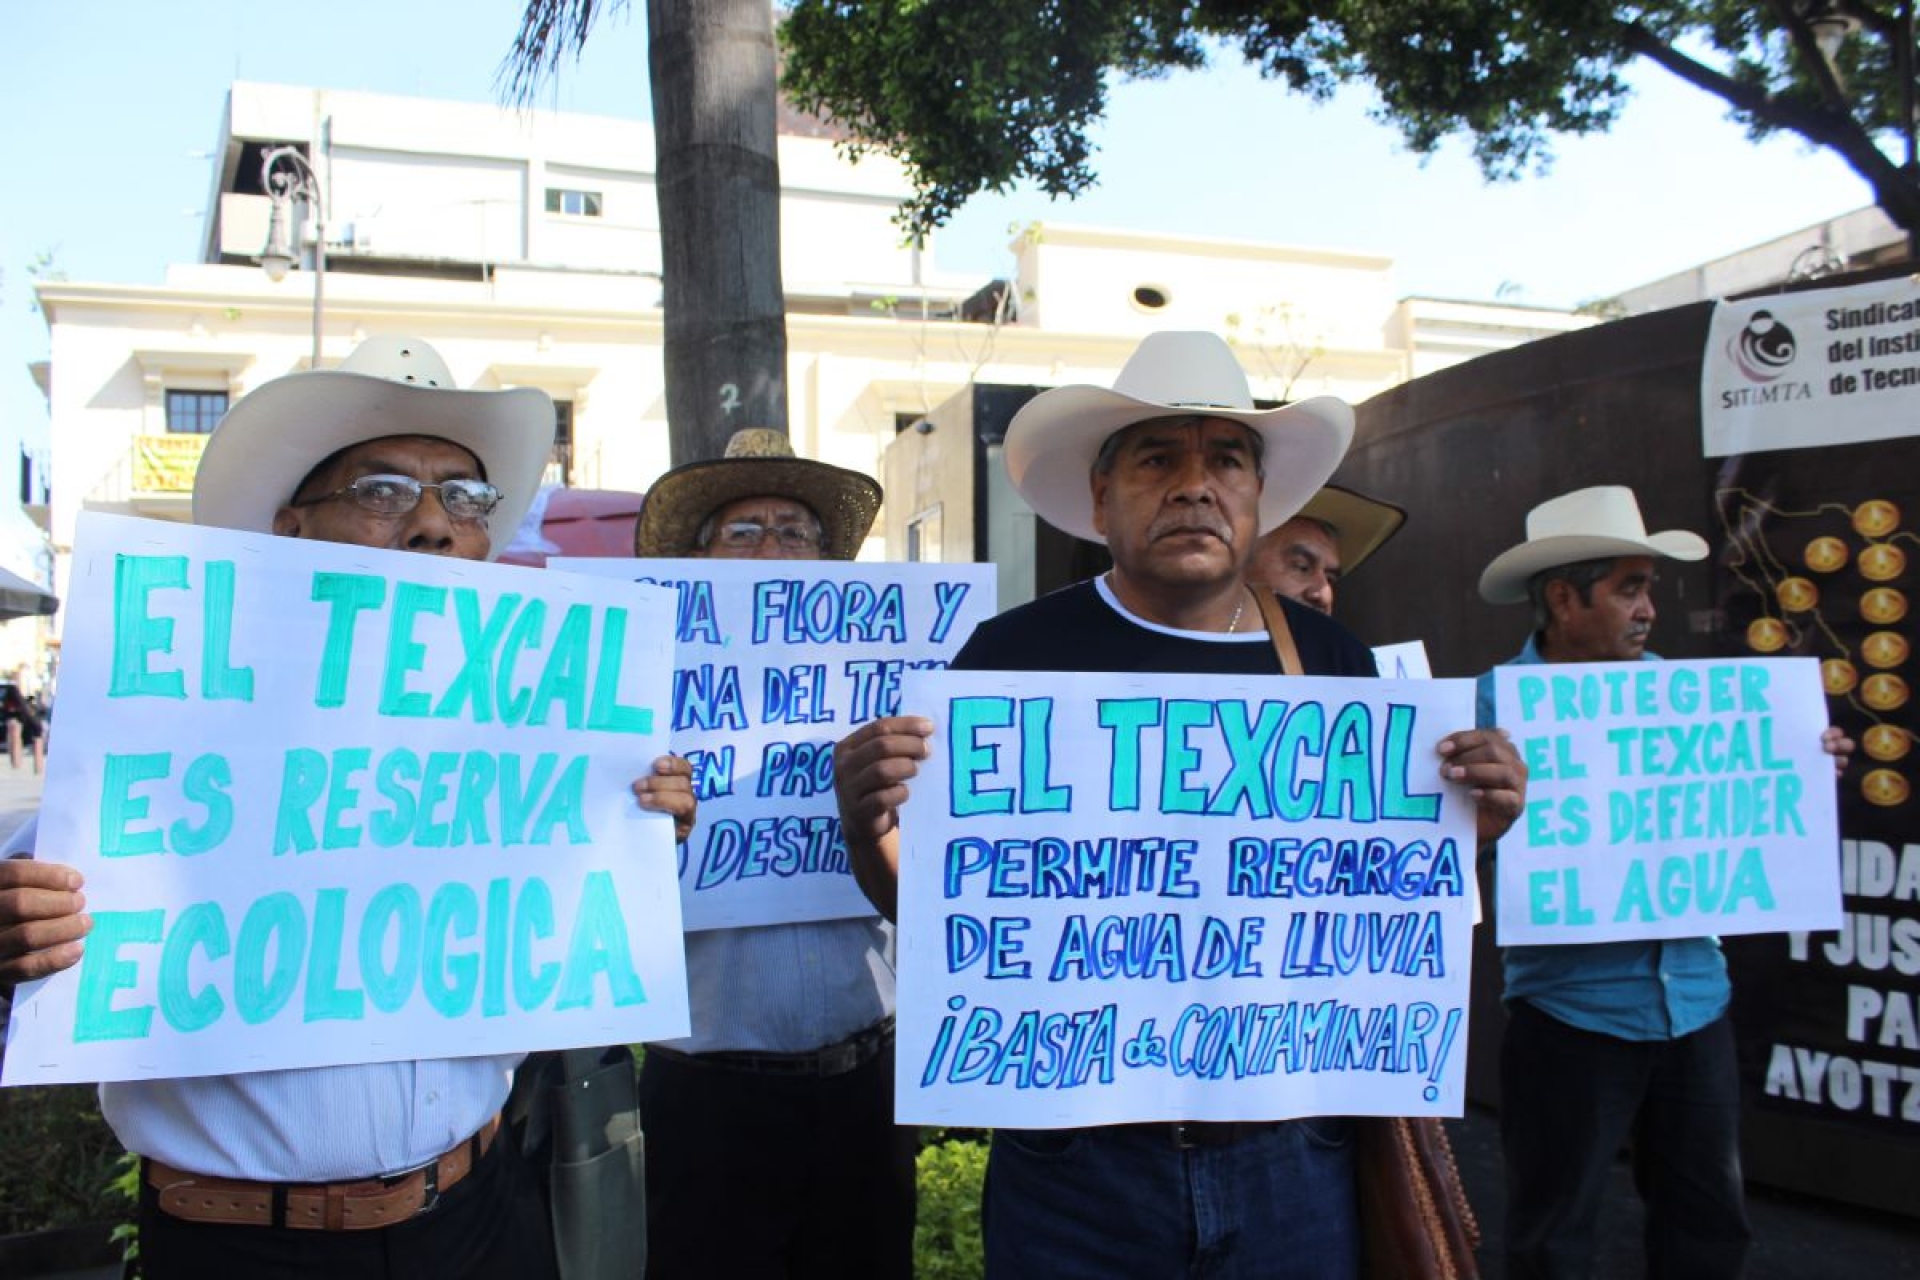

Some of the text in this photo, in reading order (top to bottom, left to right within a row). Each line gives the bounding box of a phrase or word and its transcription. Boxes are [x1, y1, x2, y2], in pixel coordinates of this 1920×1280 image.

[1828, 340, 1863, 363] del
[1829, 367, 1920, 395] de Tecn
[107, 553, 654, 735] EL TEXCAL
[752, 579, 906, 645] FLORA
[928, 581, 971, 643] Y
[762, 664, 834, 725] DEL
[1518, 665, 1771, 721] PROTEGER
[948, 697, 1443, 822] EL TEXCAL
[1525, 717, 1793, 781] EL TEXCAL
[99, 746, 593, 858] ES RESERVA
[1526, 774, 1806, 847] ES DEFENDER
[944, 834, 1463, 900] PERMITE RECARGA
[1529, 848, 1776, 926] EL AGUA
[73, 870, 648, 1043] ECOLOGICA
[945, 911, 1446, 981] DE AGUA DE LLUVIA
[1122, 1019, 1167, 1068] de
[1170, 998, 1461, 1102] CONTAMINAR!
[1847, 984, 1920, 1050] PA
